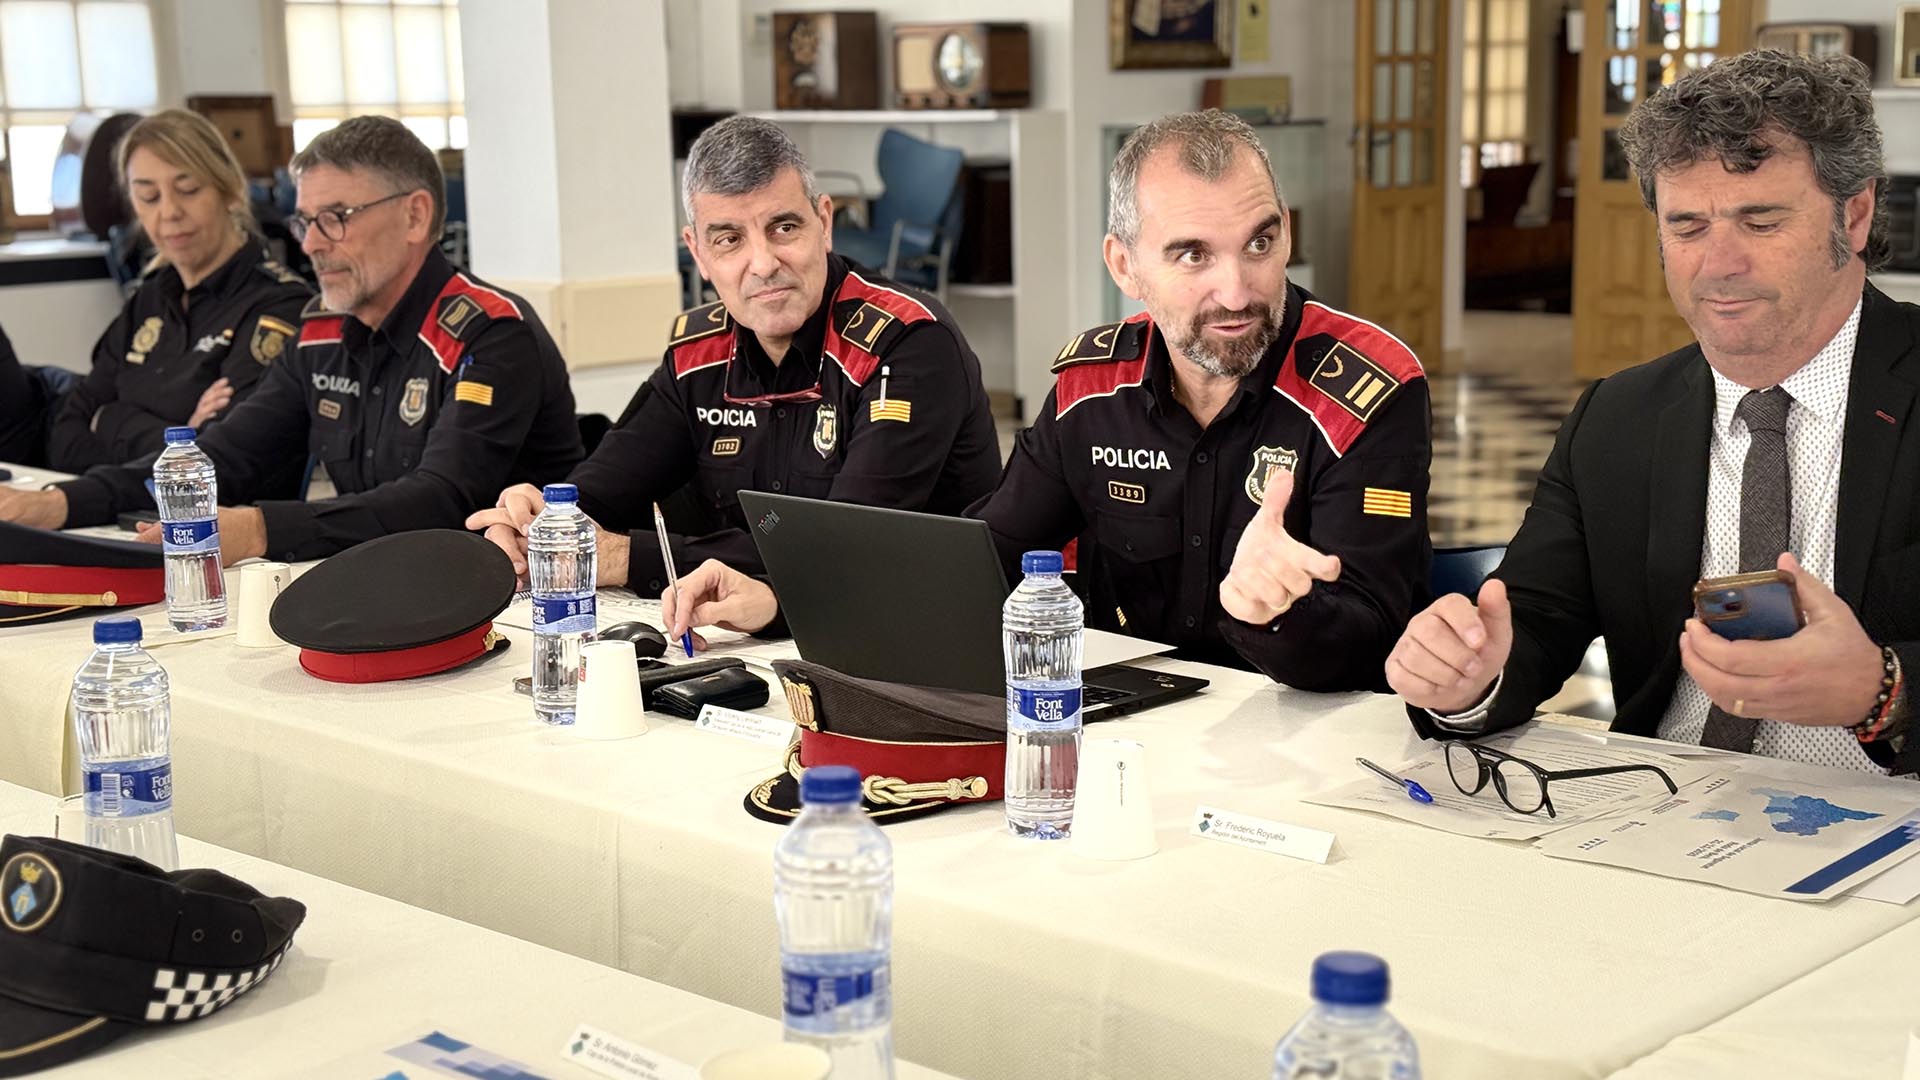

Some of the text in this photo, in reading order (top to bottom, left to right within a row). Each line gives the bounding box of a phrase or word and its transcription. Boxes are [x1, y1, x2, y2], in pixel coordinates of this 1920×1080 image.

[1091, 446, 1172, 470] POLICIA
[1261, 452, 1292, 465] POLICIA
[1113, 486, 1139, 499] 3389
[173, 527, 194, 537] Font
[173, 536, 195, 545] Vella
[1035, 697, 1063, 710] Font
[1034, 708, 1063, 721] Vella
[1256, 827, 1286, 842] Royuela
